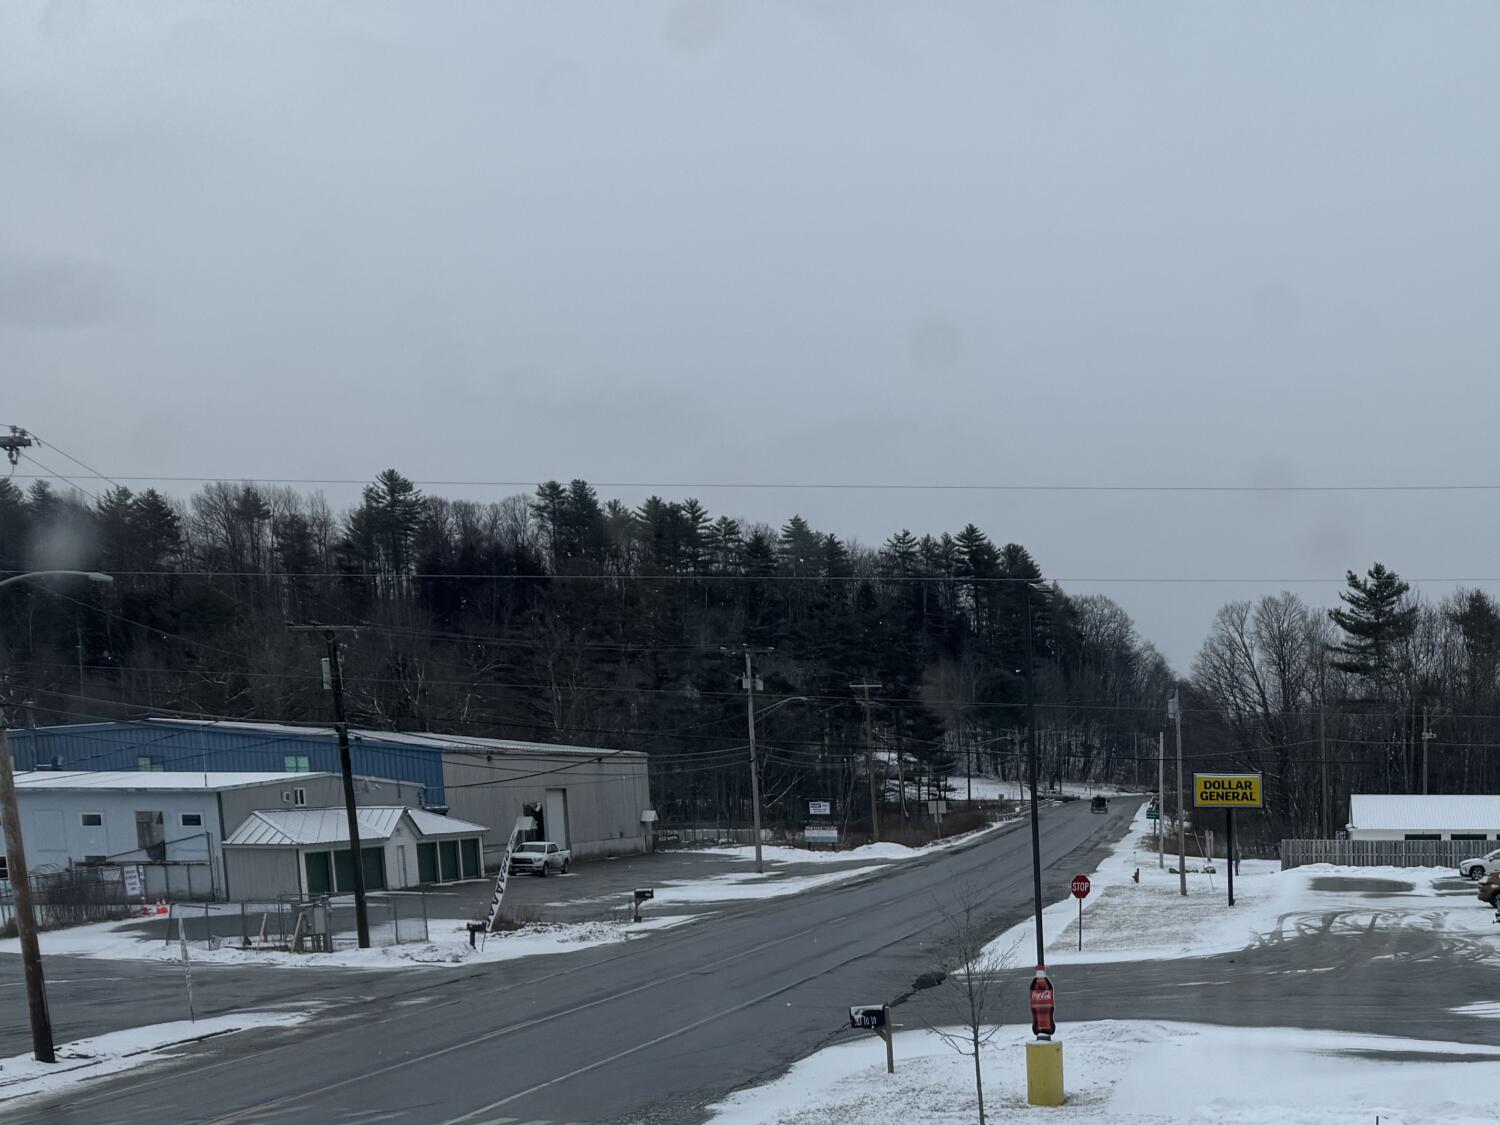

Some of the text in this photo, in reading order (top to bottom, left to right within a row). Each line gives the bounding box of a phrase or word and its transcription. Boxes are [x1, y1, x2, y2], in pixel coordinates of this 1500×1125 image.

[1203, 780, 1252, 790] DOLLAR
[1200, 791, 1256, 801] GENERAL
[1073, 882, 1089, 891] STOP
